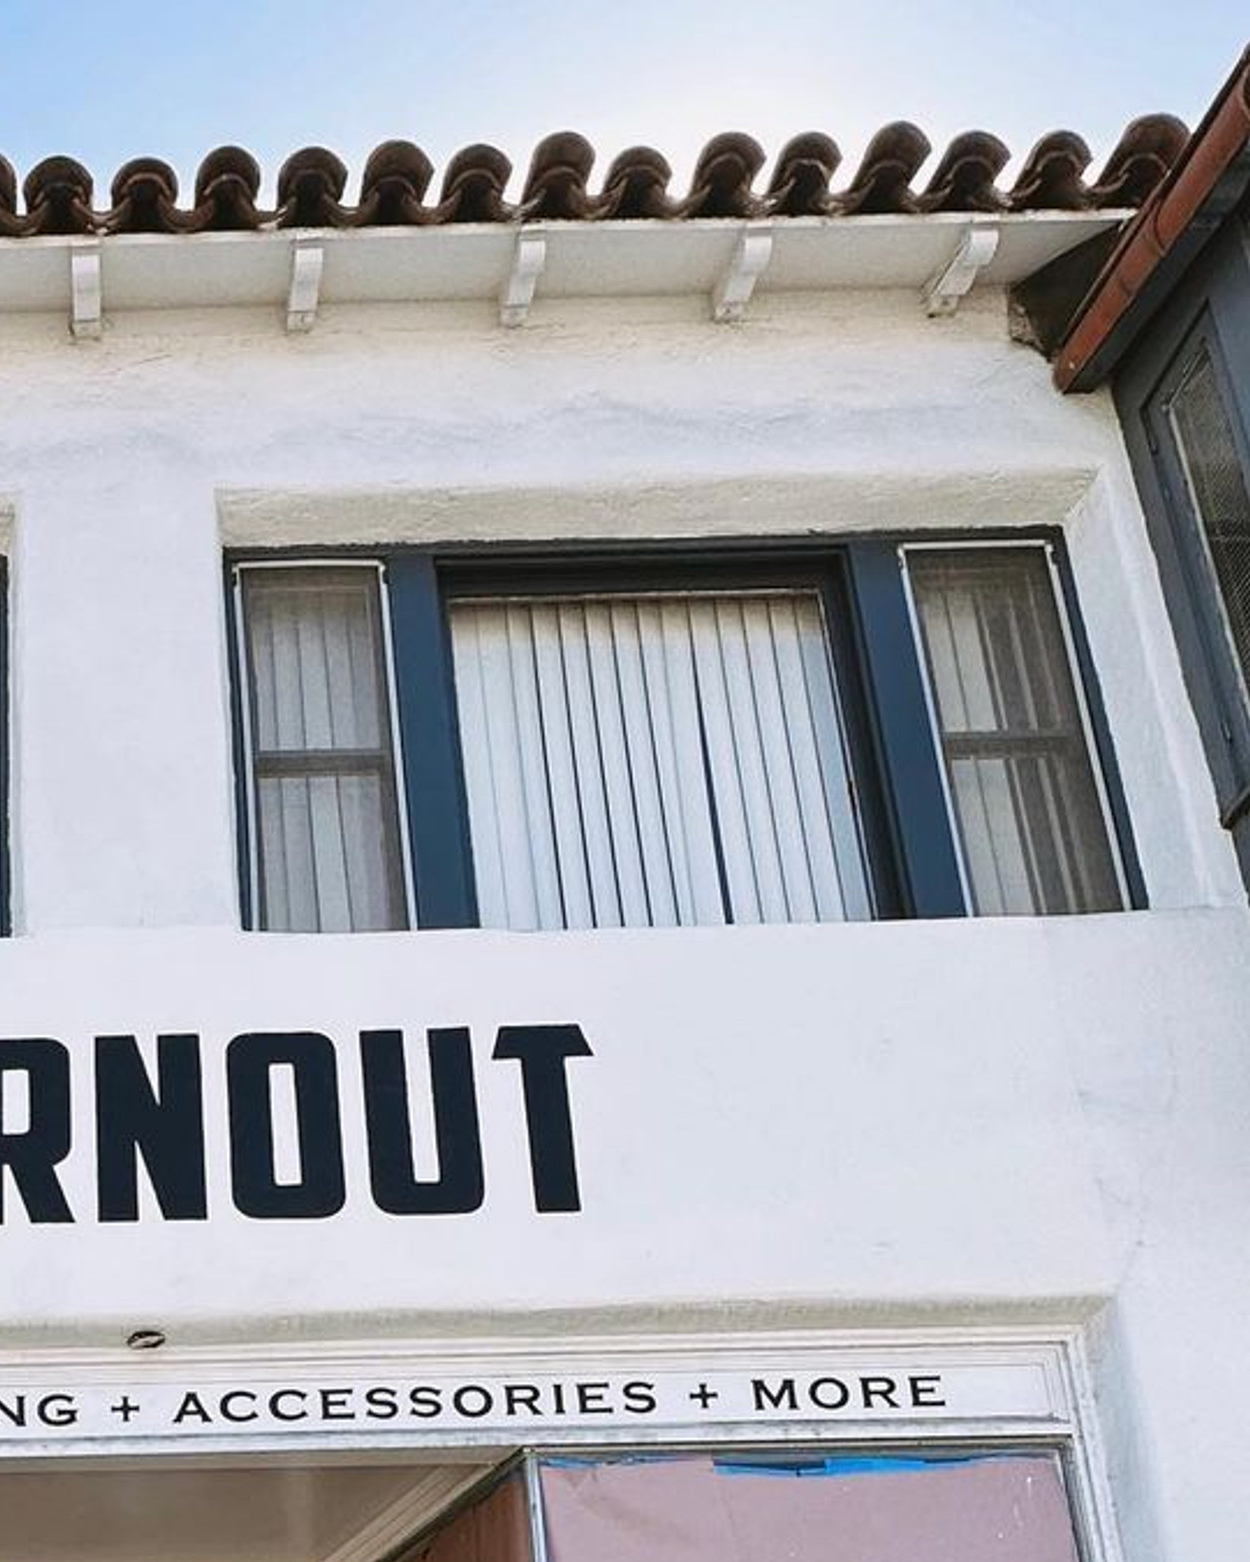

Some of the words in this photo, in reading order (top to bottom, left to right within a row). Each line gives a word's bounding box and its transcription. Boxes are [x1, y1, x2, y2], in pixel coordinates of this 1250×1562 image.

[110, 1396, 140, 1422] +
[173, 1381, 657, 1423] ACCESSORIES
[689, 1383, 719, 1409] +
[751, 1375, 946, 1411] MORE
